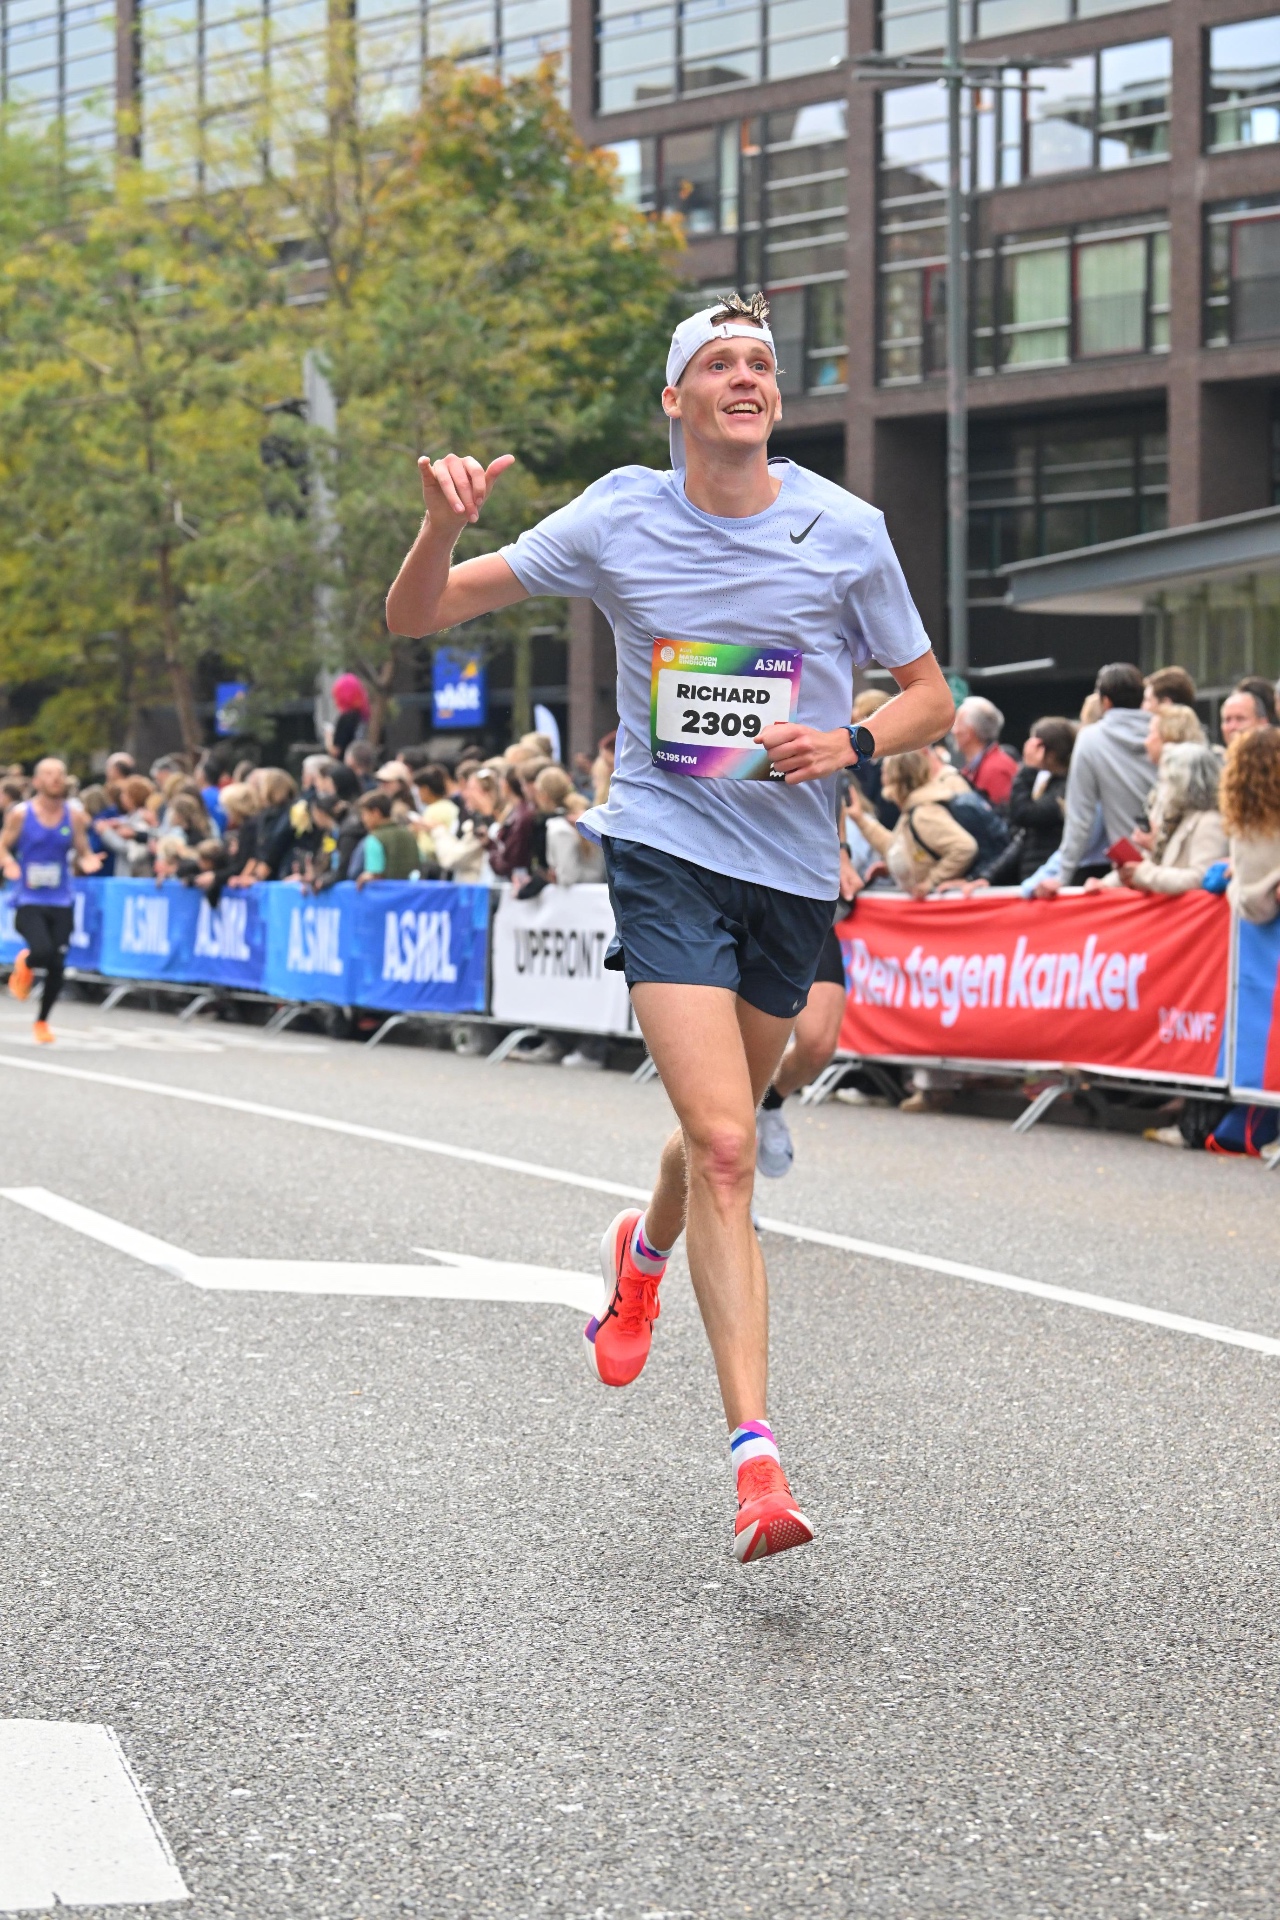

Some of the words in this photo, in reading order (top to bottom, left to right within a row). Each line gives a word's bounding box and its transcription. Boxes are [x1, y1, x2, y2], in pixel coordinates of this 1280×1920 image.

[679, 654, 718, 662] MARATHON
[755, 659, 795, 672] ASML
[677, 684, 770, 704] RICHARD
[681, 710, 762, 738] 2309
[656, 751, 680, 762] 42,195
[681, 755, 697, 764] KM
[120, 895, 171, 956] ASML
[286, 905, 344, 977] ASML
[381, 909, 459, 984] ASML
[513, 929, 606, 979] UPFRONT
[851, 938, 907, 1008] Ren
[904, 945, 1007, 1028] tegen
[1005, 934, 1148, 1011] kanker
[1175, 1010, 1217, 1045] KWF
